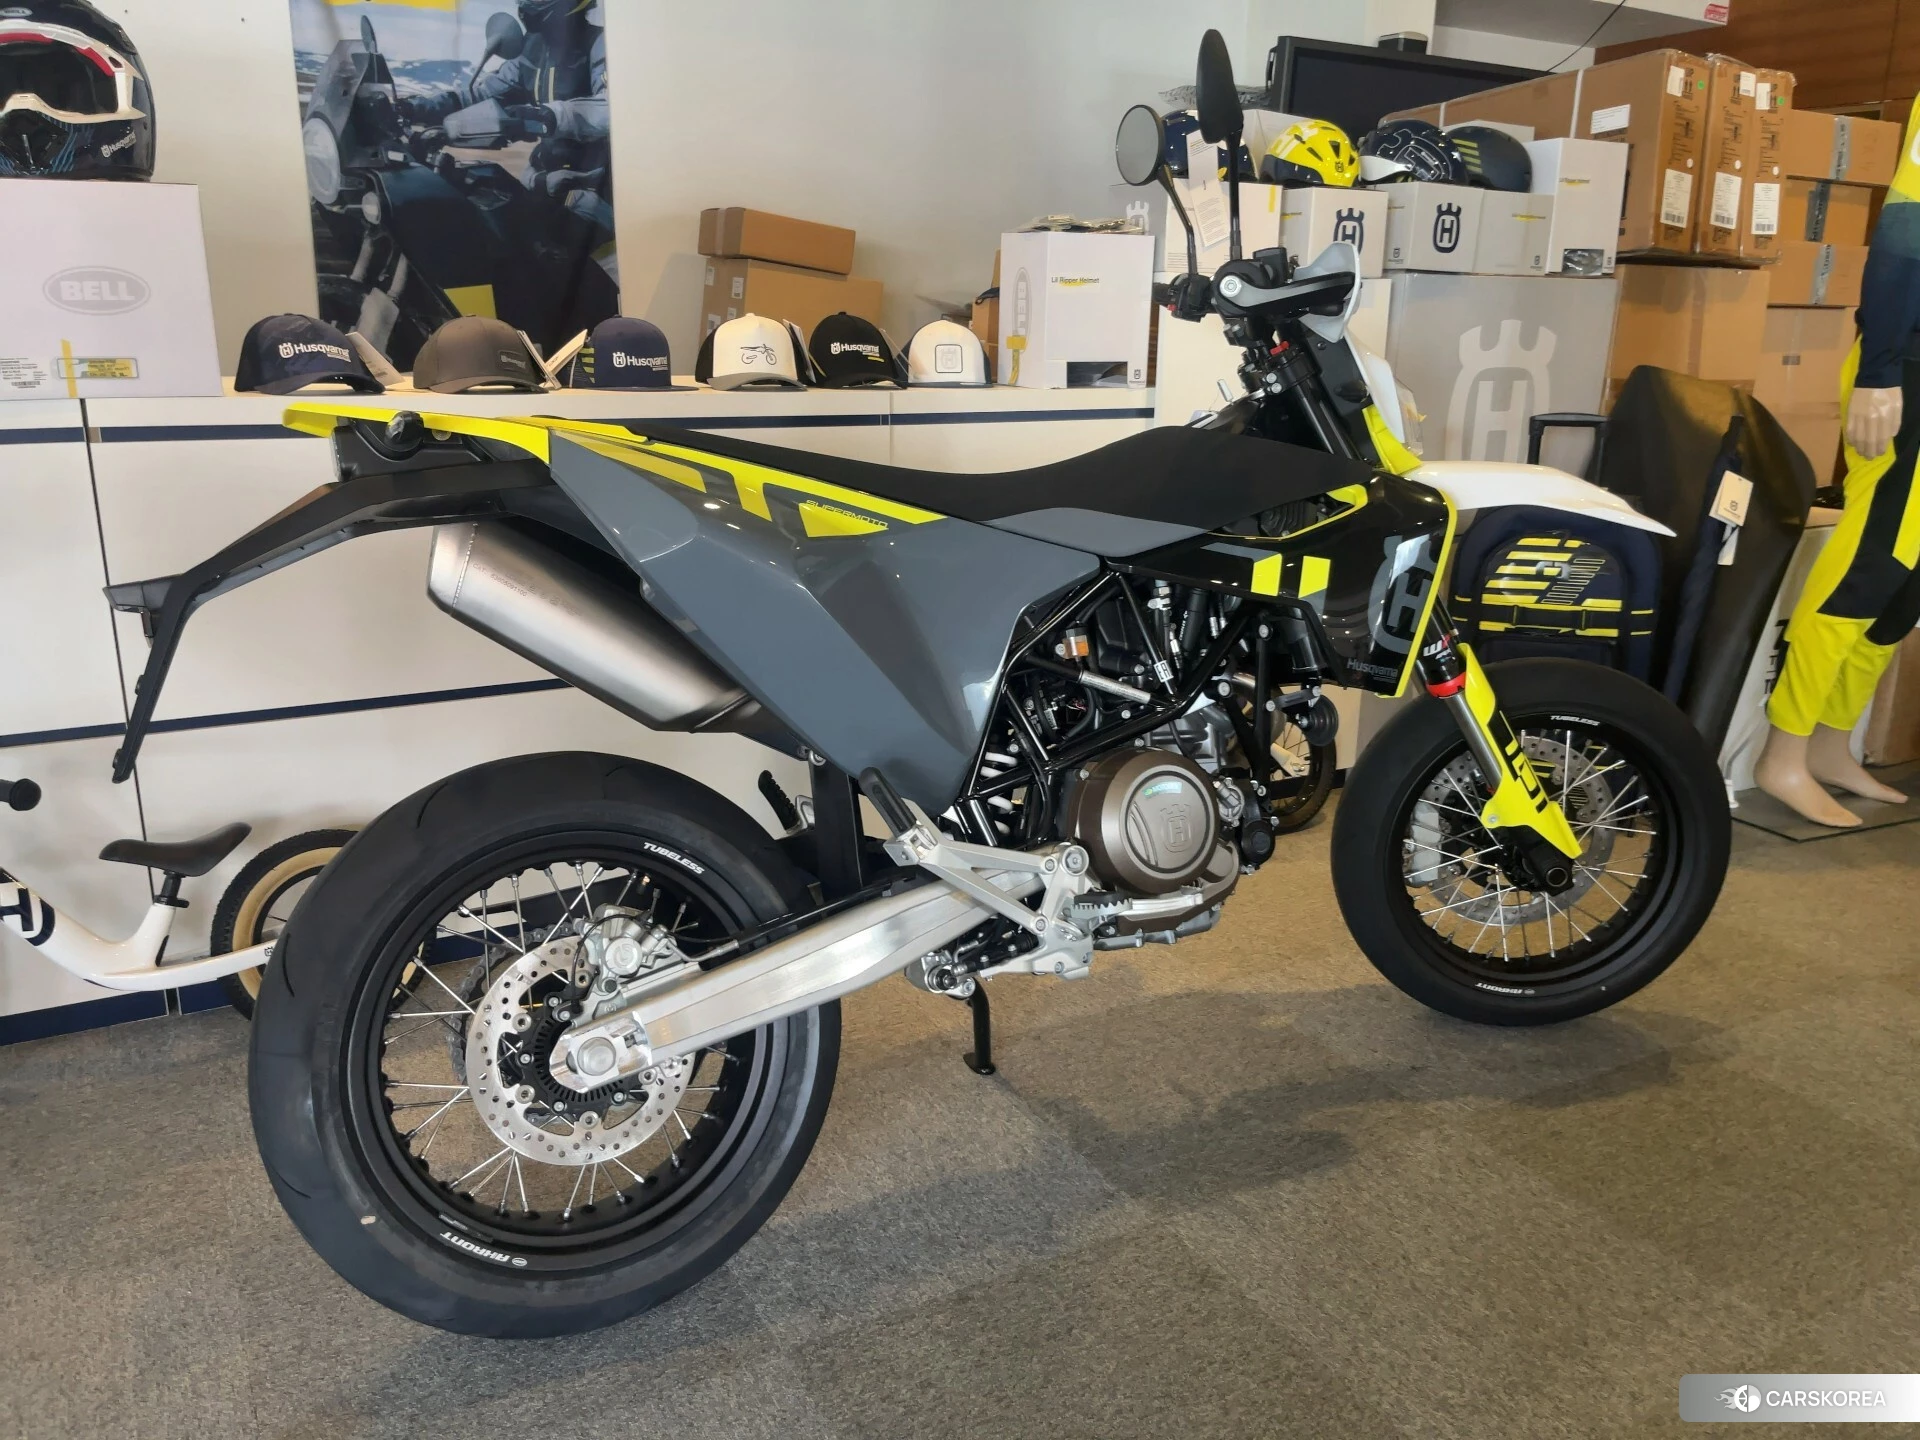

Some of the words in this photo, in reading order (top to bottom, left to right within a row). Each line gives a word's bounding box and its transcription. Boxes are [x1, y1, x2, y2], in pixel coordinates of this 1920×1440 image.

[60, 280, 135, 301] BELL
[1059, 276, 1078, 285] Ripper
[1079, 276, 1100, 284] Helmet
[806, 499, 889, 529] SUPERMOTO
[1346, 657, 1399, 677] Husqvarna
[1550, 715, 1601, 727] TUBELESS
[643, 841, 705, 874] TUBELESS
